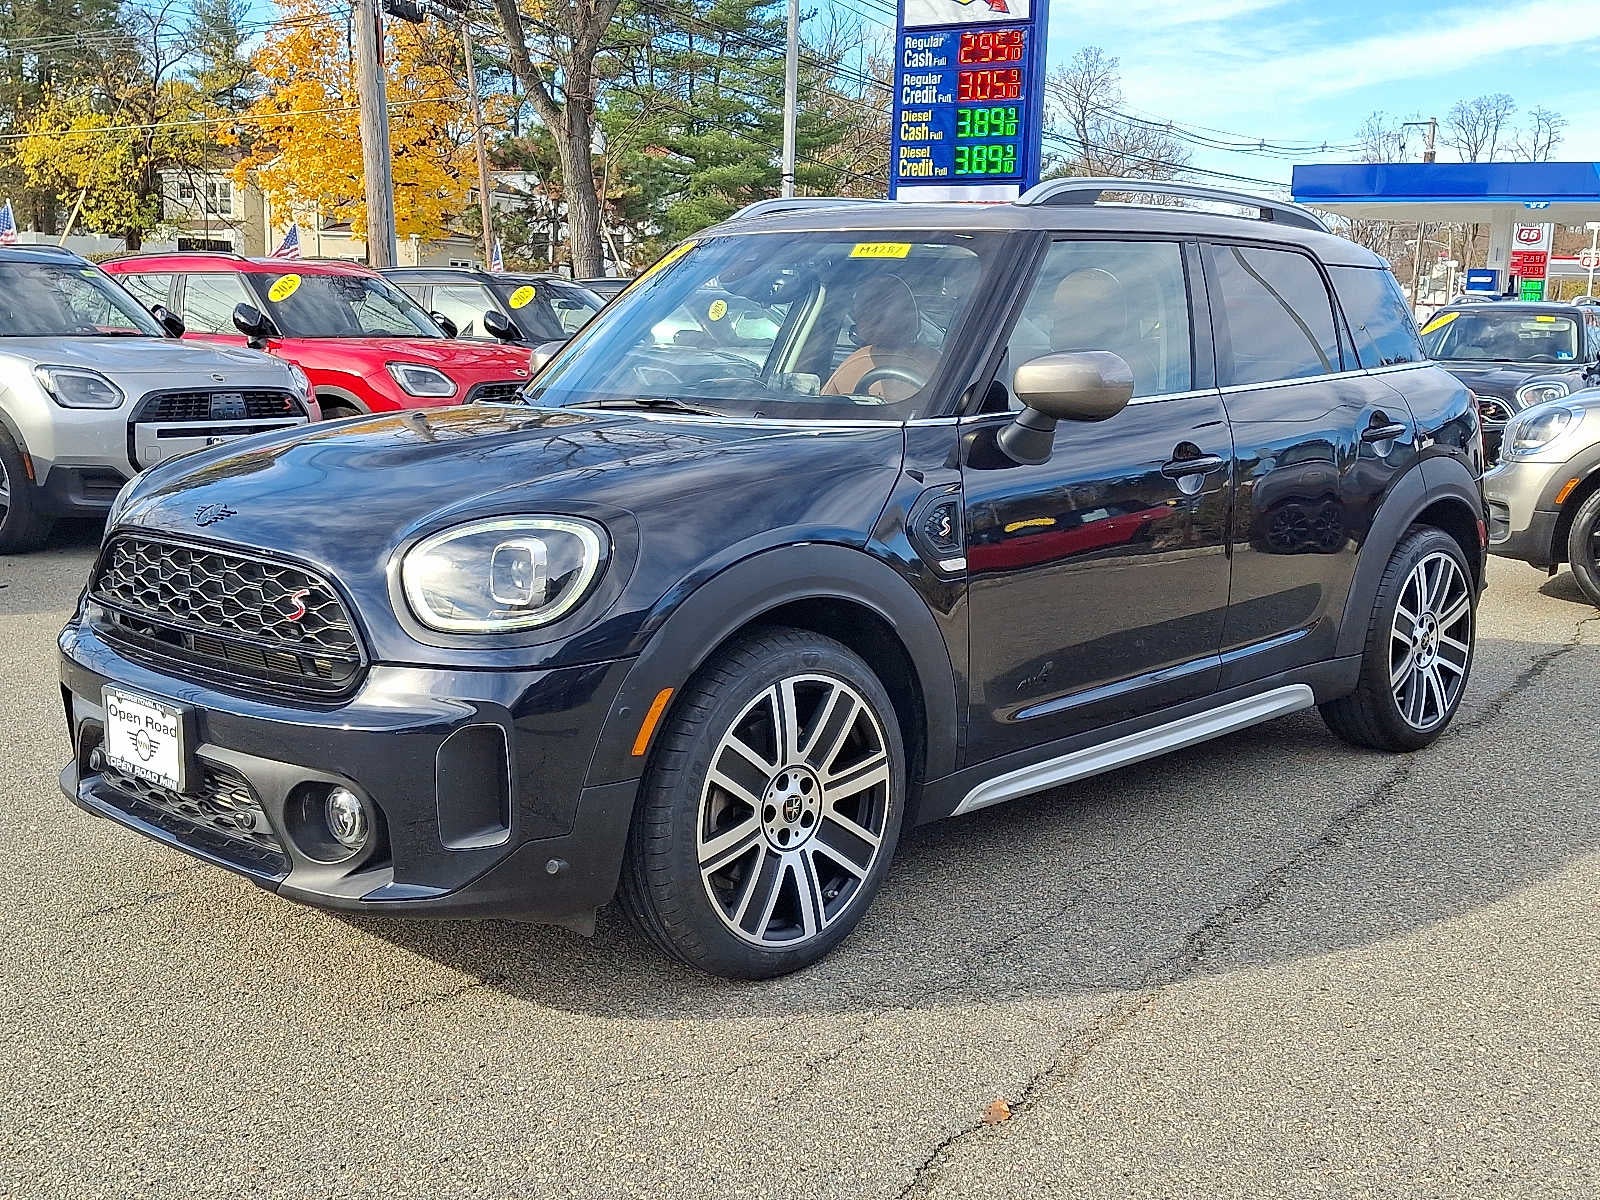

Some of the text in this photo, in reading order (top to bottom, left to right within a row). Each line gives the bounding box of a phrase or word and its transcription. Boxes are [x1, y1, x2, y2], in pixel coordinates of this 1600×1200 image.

[904, 35, 945, 51] Regular
[904, 48, 947, 68] Cash Full
[903, 72, 943, 88] Regular
[902, 85, 952, 105] Credit Full
[901, 109, 932, 123] Diesel
[900, 122, 943, 141] Cash Full
[899, 145, 931, 159] Diesel
[898, 158, 948, 177] Credit Full
[1520, 229, 1540, 241] 66
[938, 516, 951, 537] S
[284, 588, 311, 622] S
[109, 703, 177, 738] Open Road
[109, 756, 133, 773] OPEN
[134, 765, 159, 783] ROAD
